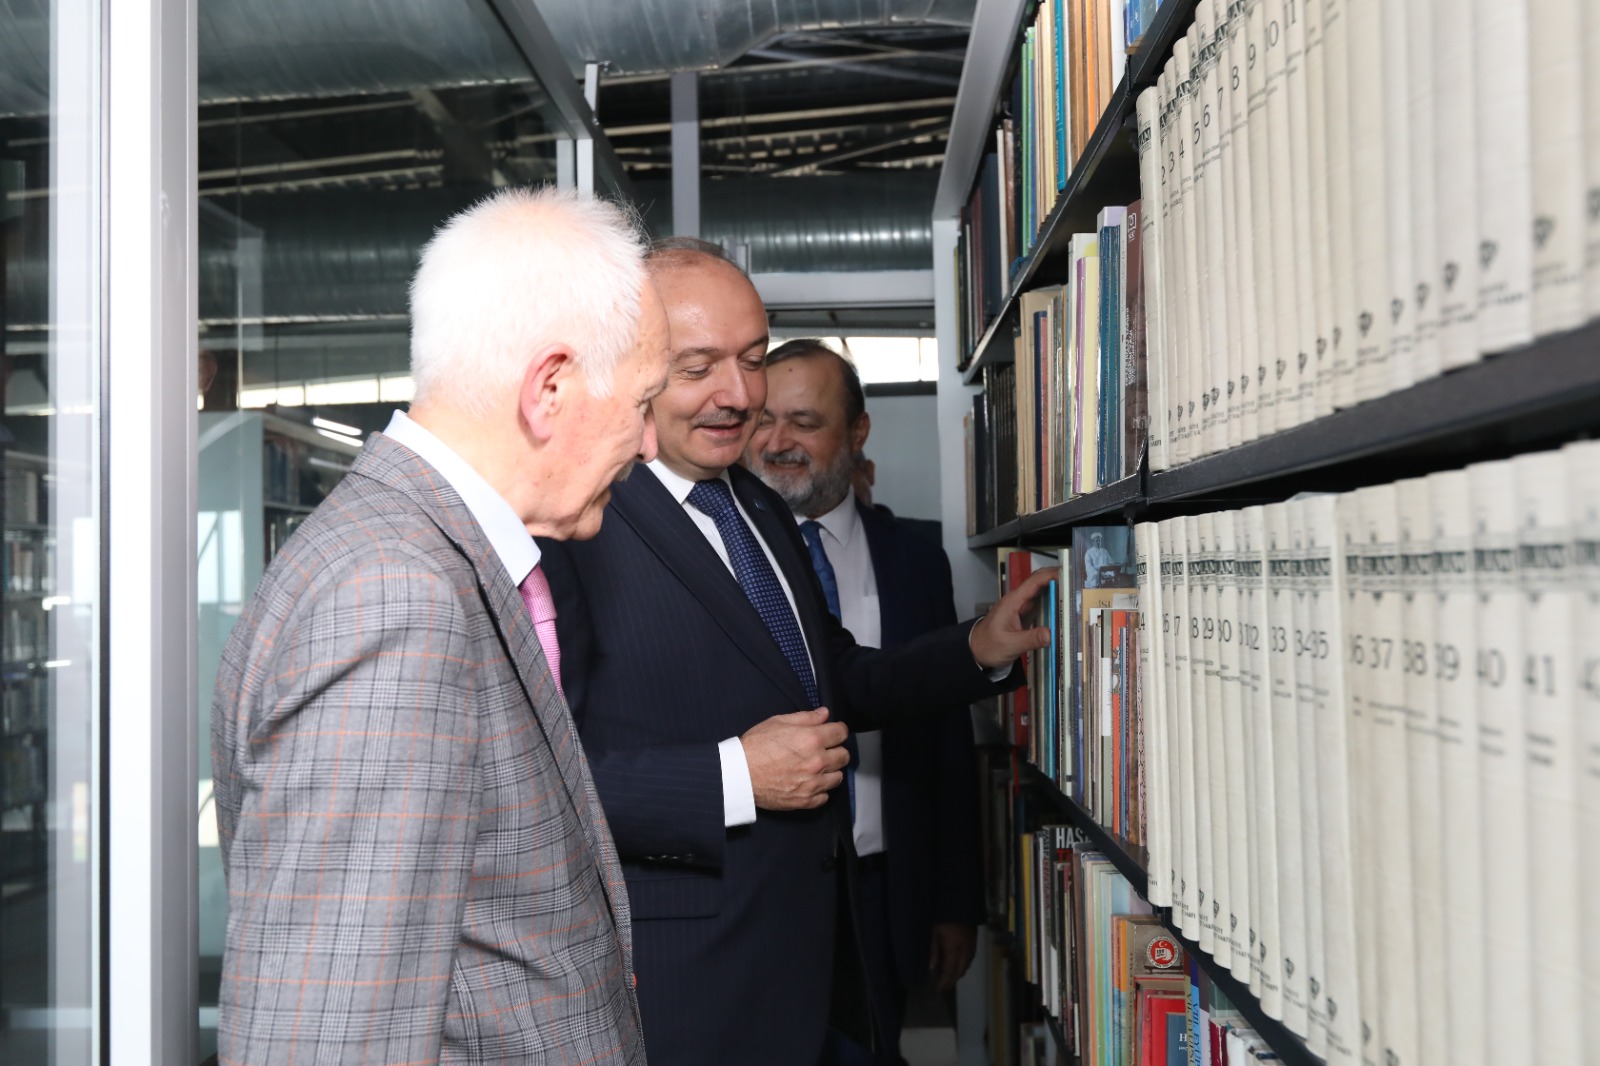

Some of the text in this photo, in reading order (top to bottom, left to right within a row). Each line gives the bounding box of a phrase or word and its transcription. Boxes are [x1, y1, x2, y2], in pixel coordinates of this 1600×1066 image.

[1248, 43, 1256, 71] 9
[1232, 65, 1240, 91] 8
[1217, 86, 1223, 111] 7
[1203, 104, 1211, 128] 6
[1193, 121, 1201, 145] 5
[1179, 138, 1185, 158] 4
[1168, 151, 1175, 173] 3
[1161, 166, 1166, 186] 2
[1139, 612, 1145, 631] 4
[1174, 615, 1181, 636] 7
[1192, 617, 1199, 639] 8
[1249, 625, 1259, 650] 2
[1369, 636, 1394, 670] 37
